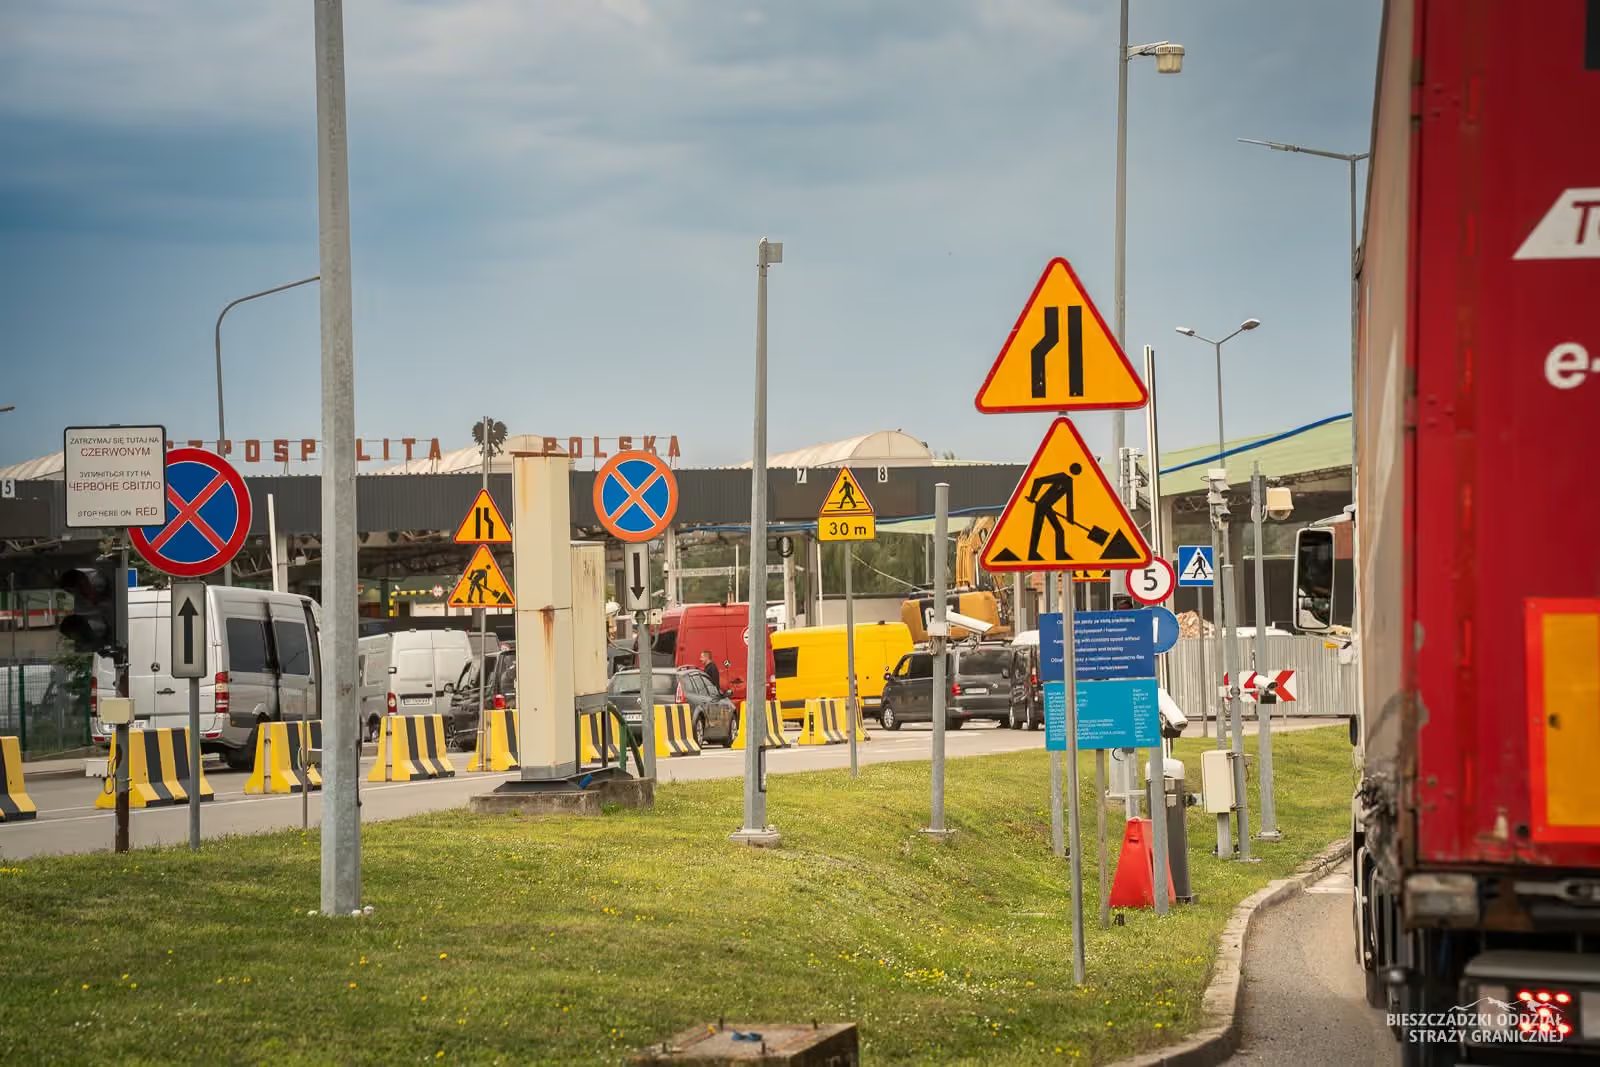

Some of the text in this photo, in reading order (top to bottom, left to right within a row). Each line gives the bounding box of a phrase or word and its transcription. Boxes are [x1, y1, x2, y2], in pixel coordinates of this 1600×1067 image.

[1571, 201, 1600, 245] T
[70, 437, 112, 445] ZATRZYMAJ
[113, 437, 124, 445] SIĘ
[126, 436, 148, 444] TUTAJ
[543, 435, 681, 459] POLSKA
[80, 447, 150, 457] CZERWONYM
[126, 470, 138, 478] ТУТ
[798, 468, 805, 482] 7
[879, 466, 886, 481] 8
[5, 480, 11, 495] 5
[69, 481, 161, 492] ЧЕРВОНЕ СВІТЛО
[135, 506, 158, 516] RED
[829, 521, 867, 536] 30 m
[1143, 568, 1158, 591] 5
